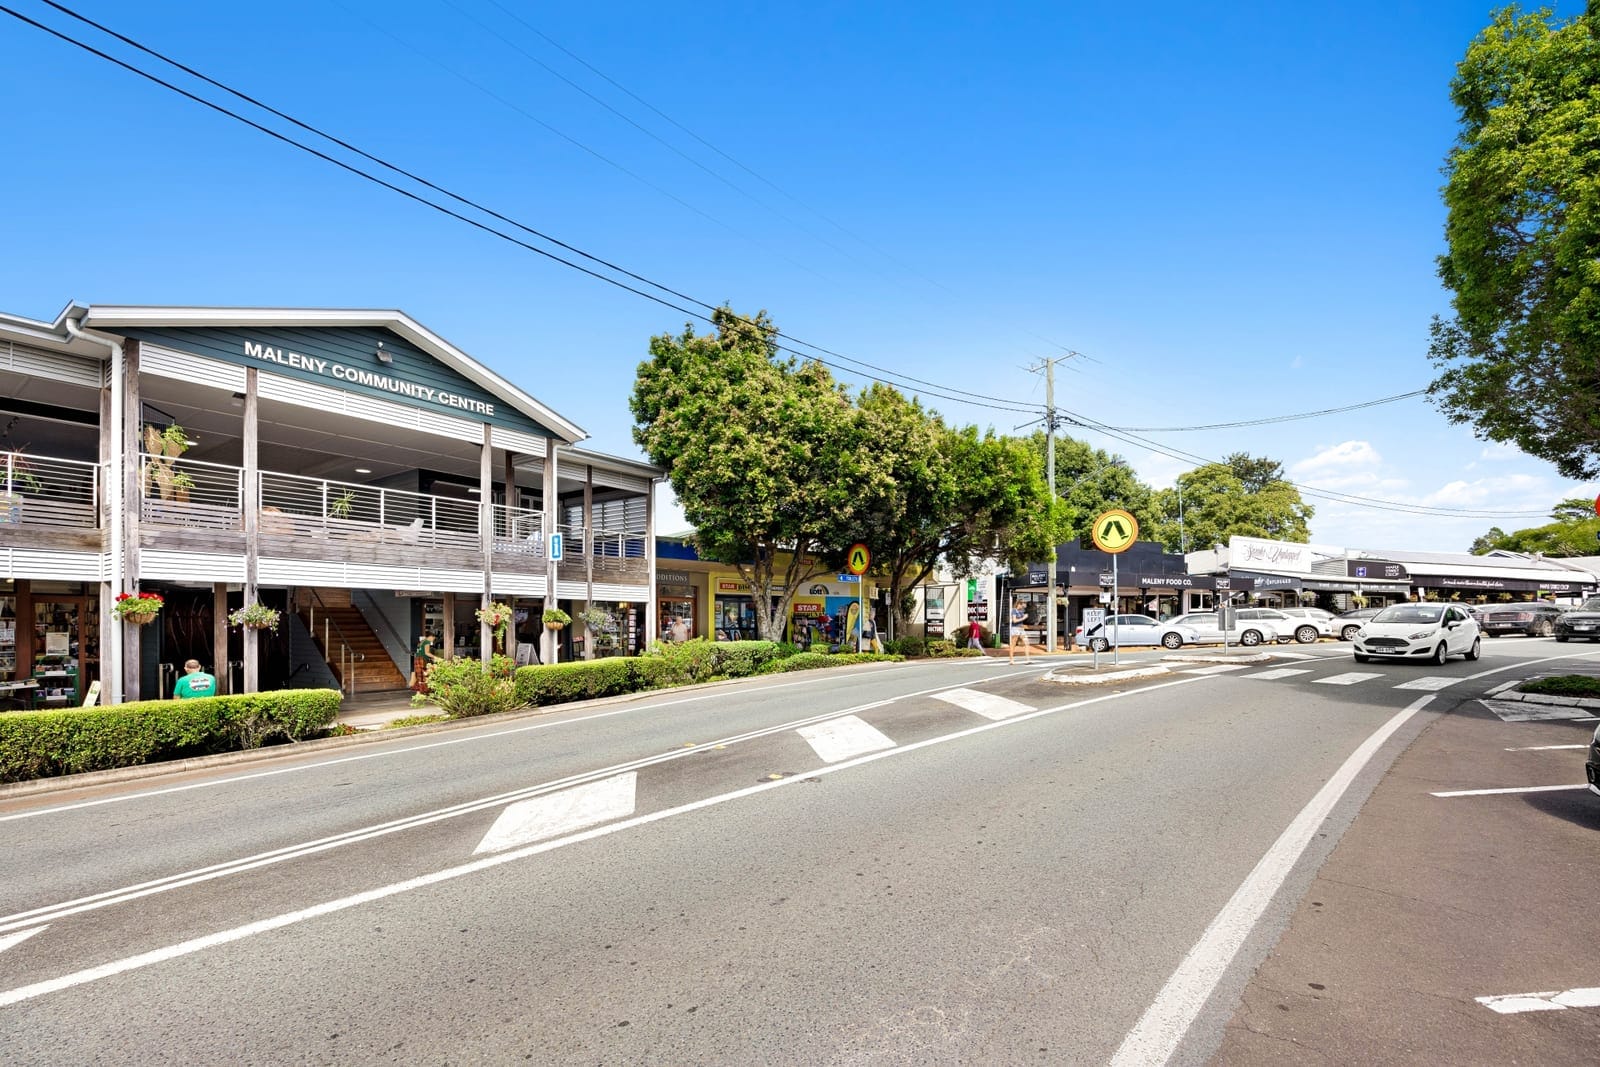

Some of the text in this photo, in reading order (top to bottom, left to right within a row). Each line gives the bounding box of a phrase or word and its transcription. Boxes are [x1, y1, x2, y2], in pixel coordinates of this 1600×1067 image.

[244, 341, 495, 416] MALENY COMMUNITY CENTRE
[797, 604, 818, 612] STAR
[967, 606, 988, 614] DOCORS
